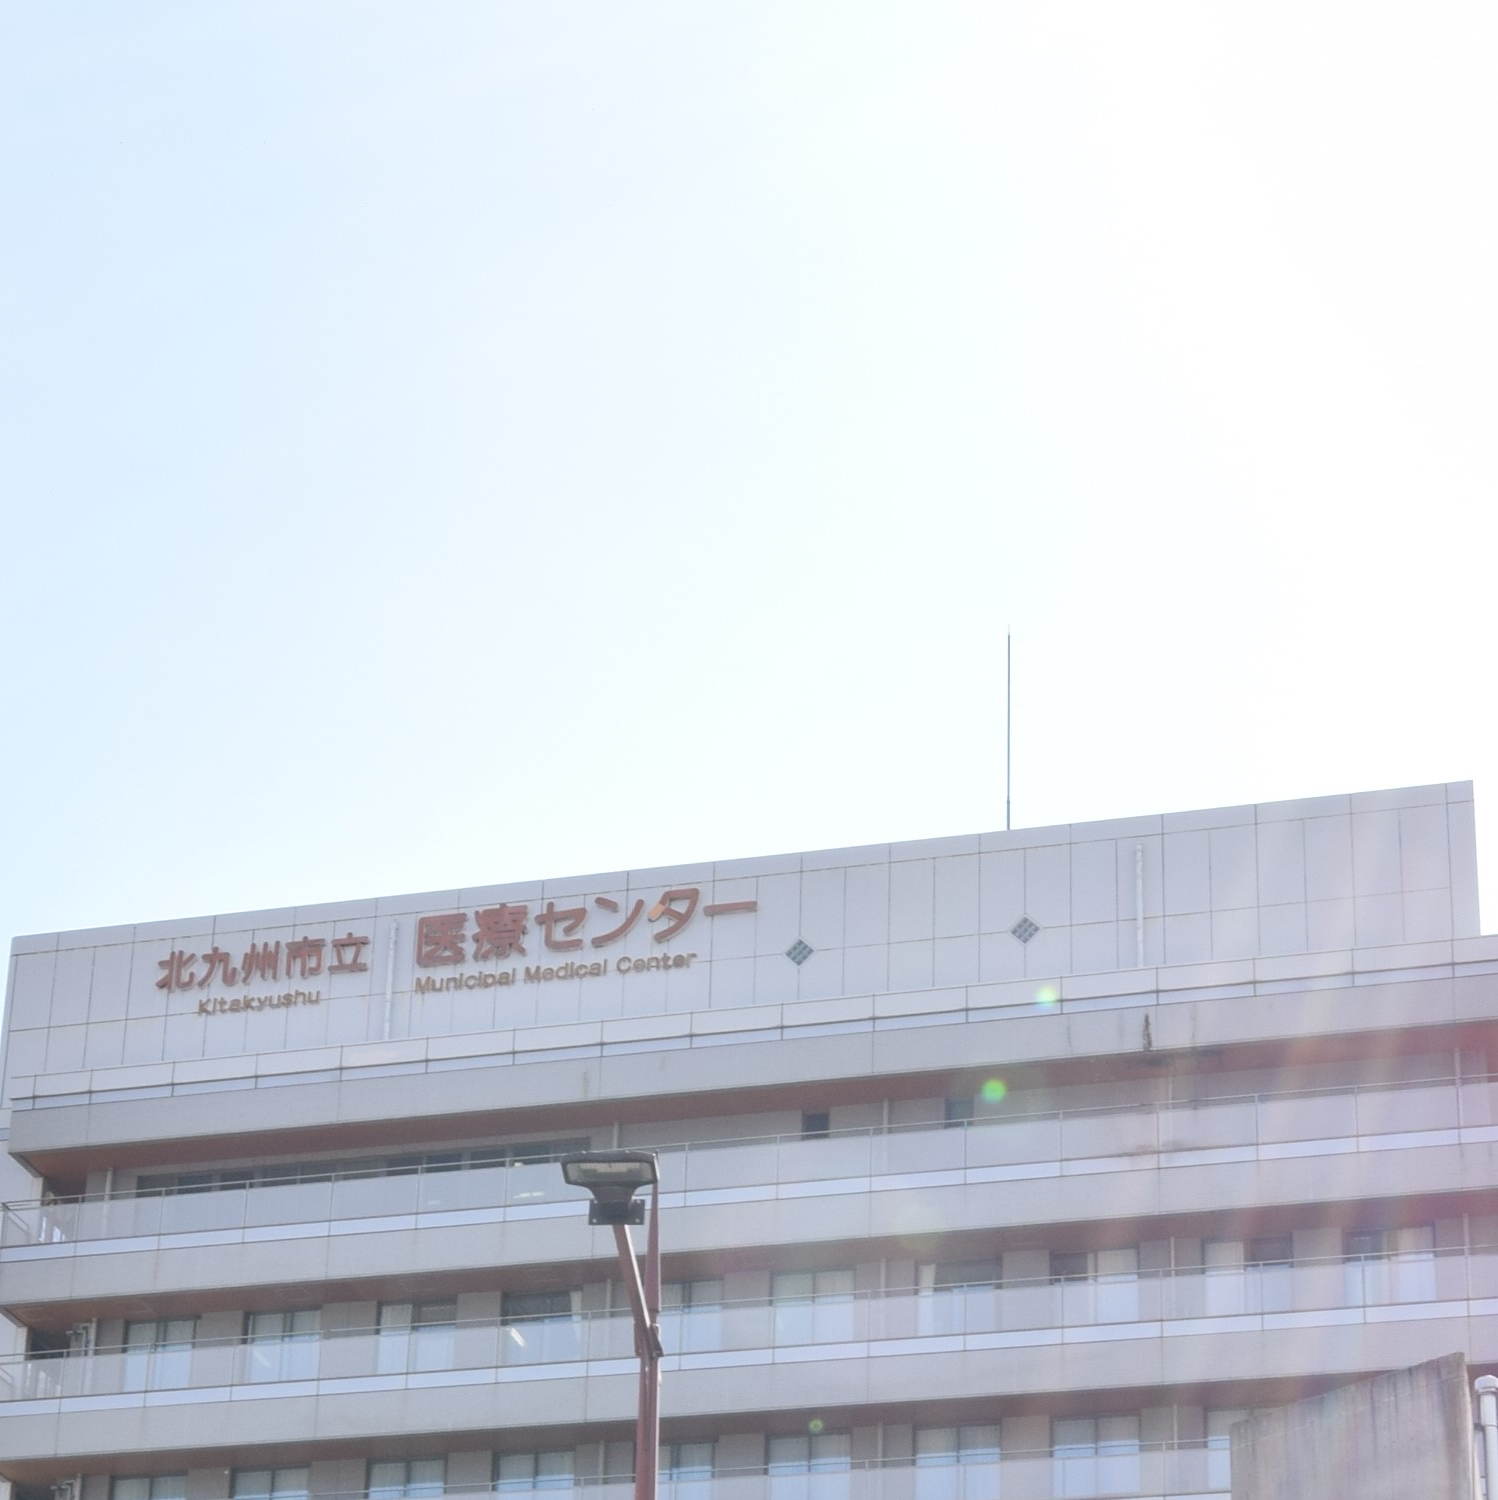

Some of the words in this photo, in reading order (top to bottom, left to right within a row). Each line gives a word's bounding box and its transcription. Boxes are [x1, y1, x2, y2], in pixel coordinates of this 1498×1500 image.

[156, 932, 371, 993] 北九州市立
[415, 887, 758, 968] 医療センター
[198, 989, 322, 1017] Kitakyushu
[414, 967, 517, 995] Municipal
[524, 958, 608, 984] Medical
[616, 952, 698, 975] Center
